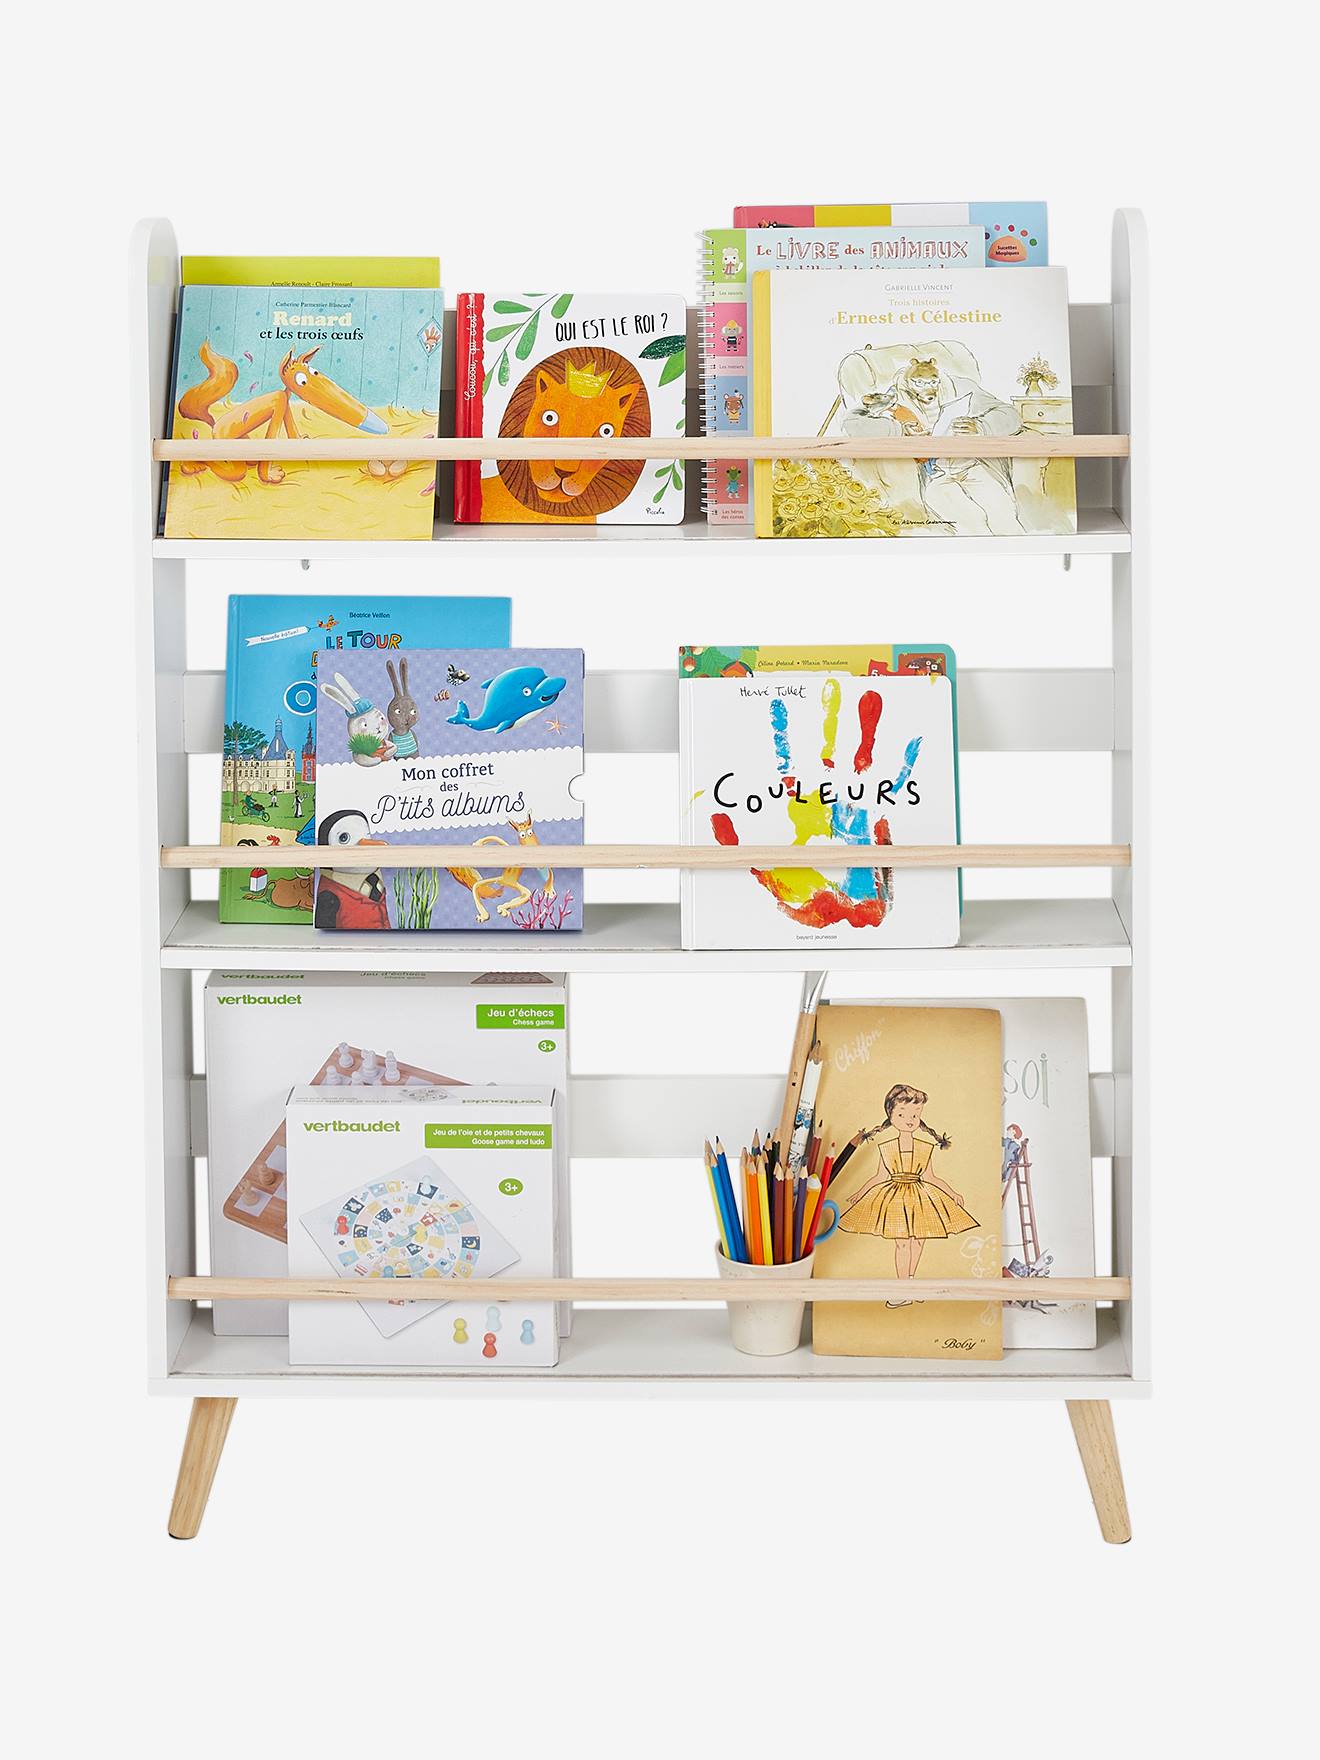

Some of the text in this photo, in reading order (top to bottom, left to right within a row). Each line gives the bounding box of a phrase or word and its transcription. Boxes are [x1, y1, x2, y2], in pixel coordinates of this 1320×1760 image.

[756, 245, 772, 256] Le
[844, 244, 865, 256] des
[884, 283, 953, 292] GABRIELLE VINCENT
[888, 298, 950, 306] Trois histoires
[272, 310, 353, 327] Renard
[900, 312, 916, 324] et
[921, 310, 1003, 324] Célestine
[259, 327, 364, 340] et les trois œufs
[556, 322, 577, 342] QUI
[582, 318, 606, 340] EST
[612, 316, 628, 337] LE
[634, 314, 655, 334] ROI
[326, 630, 403, 650] LE TOUR
[740, 685, 807, 698] Hervé Tullet
[402, 762, 495, 781] Mon coffret
[440, 782, 459, 792] des
[713, 772, 921, 813] COULEURS
[371, 791, 525, 825] P'tits albums
[217, 994, 302, 1005] vertbaudet
[487, 1008, 555, 1017] Jeu d'échecs
[540, 1041, 554, 1051] 3+
[303, 1120, 400, 1132] vertbaudet
[433, 1128, 545, 1138] Jeu de l'oie et de petits chevaux
[495, 1138, 514, 1146] game
[504, 1182, 518, 1192] 3+
